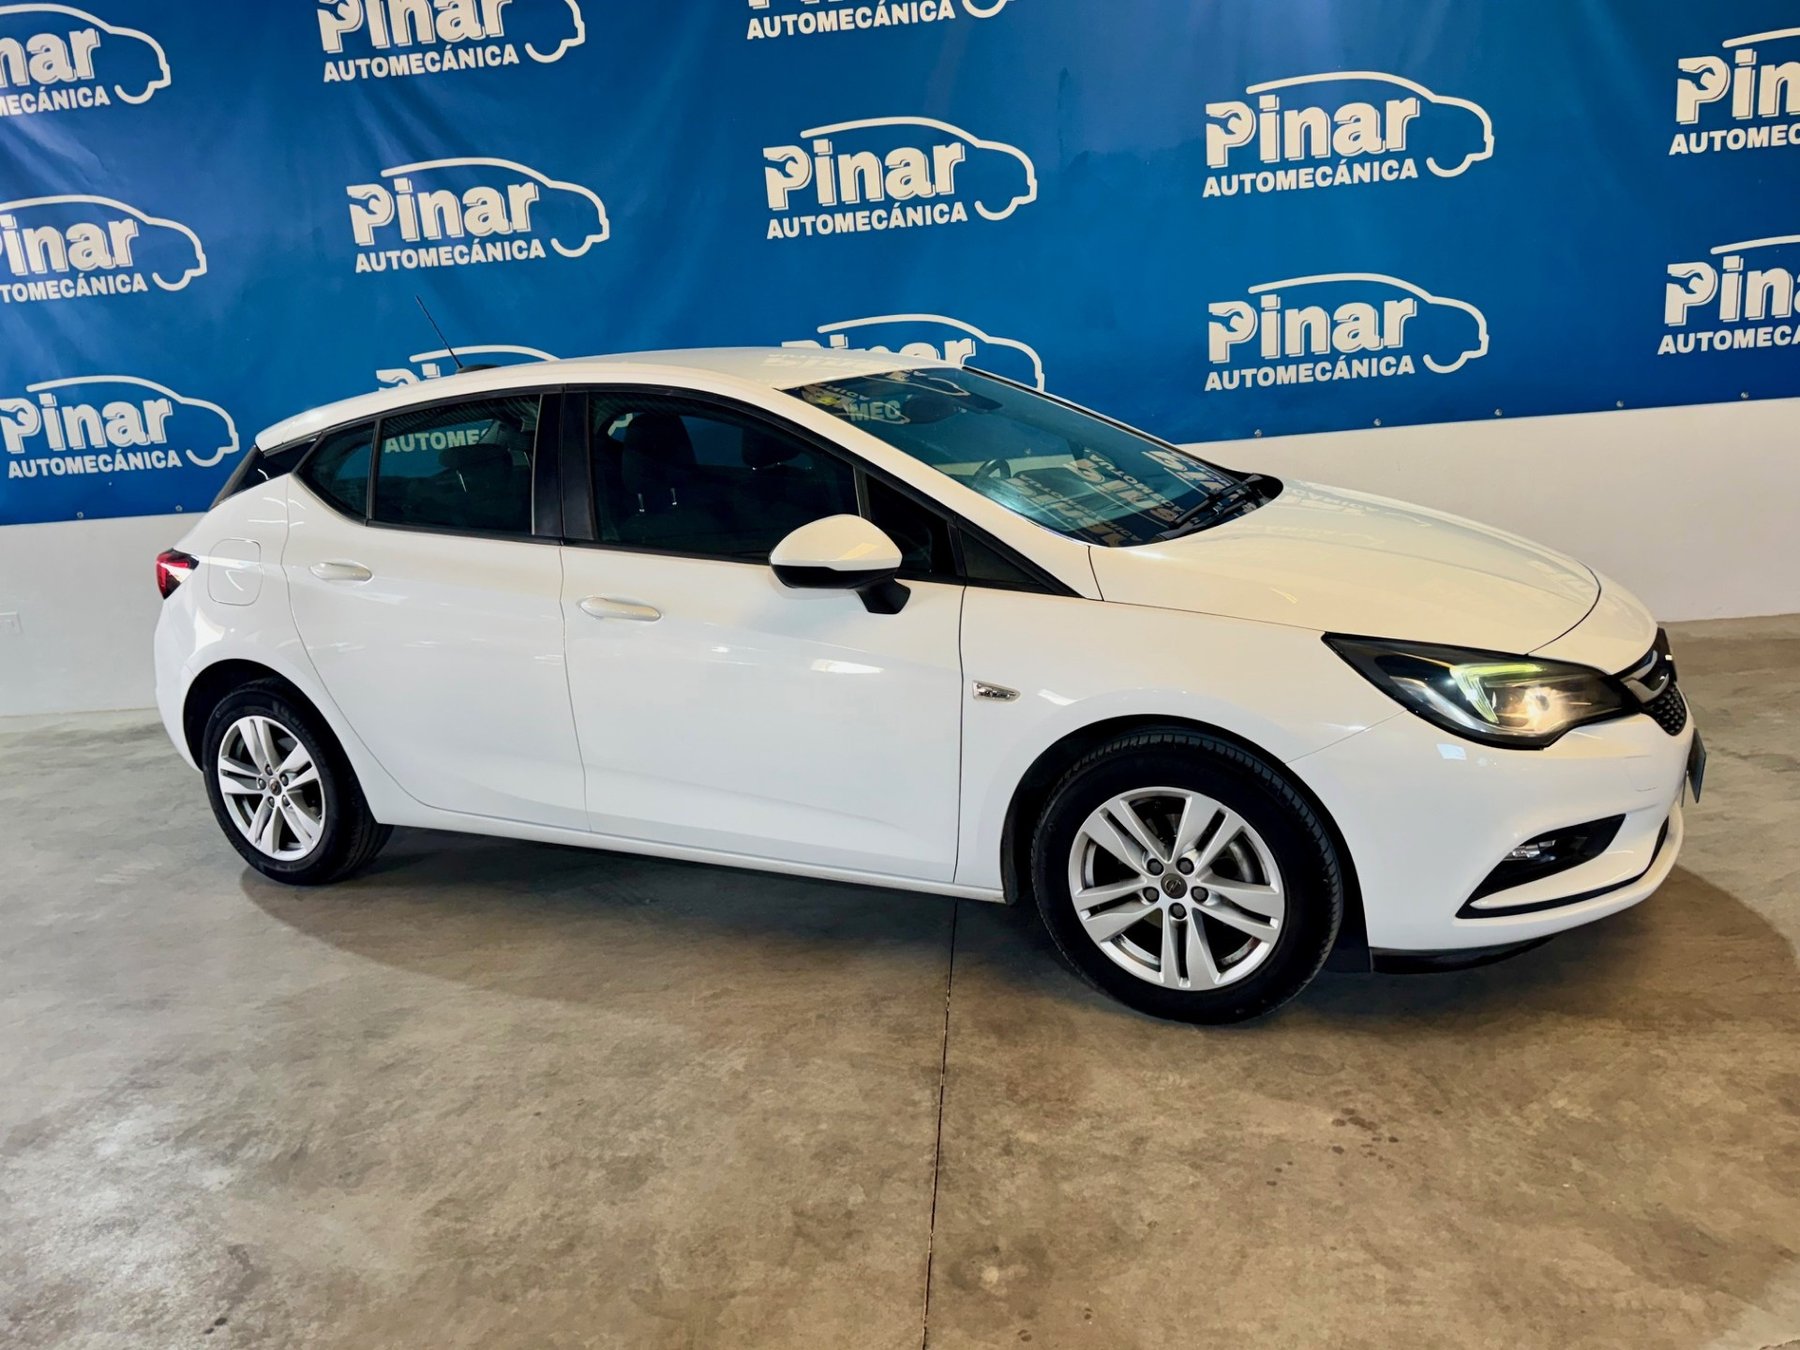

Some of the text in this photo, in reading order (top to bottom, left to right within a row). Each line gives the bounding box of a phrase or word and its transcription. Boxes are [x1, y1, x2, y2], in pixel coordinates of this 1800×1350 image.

[747, 0, 956, 40] AUTOMECÁNICA
[324, 44, 520, 83] AUTOMECÁNICA
[1205, 95, 1420, 168] Pinar
[763, 139, 965, 210] Pinar
[1202, 159, 1418, 198] AUTOMECÁNICA
[347, 177, 539, 246] Pinar
[766, 202, 967, 240] AUTOMECÁNICA
[0, 214, 139, 276] inar
[355, 239, 545, 273] AUTOMECÁNICA
[1664, 255, 1800, 327] Pin
[1208, 294, 1416, 363] Pinar
[1204, 355, 1415, 392] AUTOMECÁNICA
[0, 393, 173, 454] Pinar
[8, 449, 182, 479] AUTOMECÁNICA
